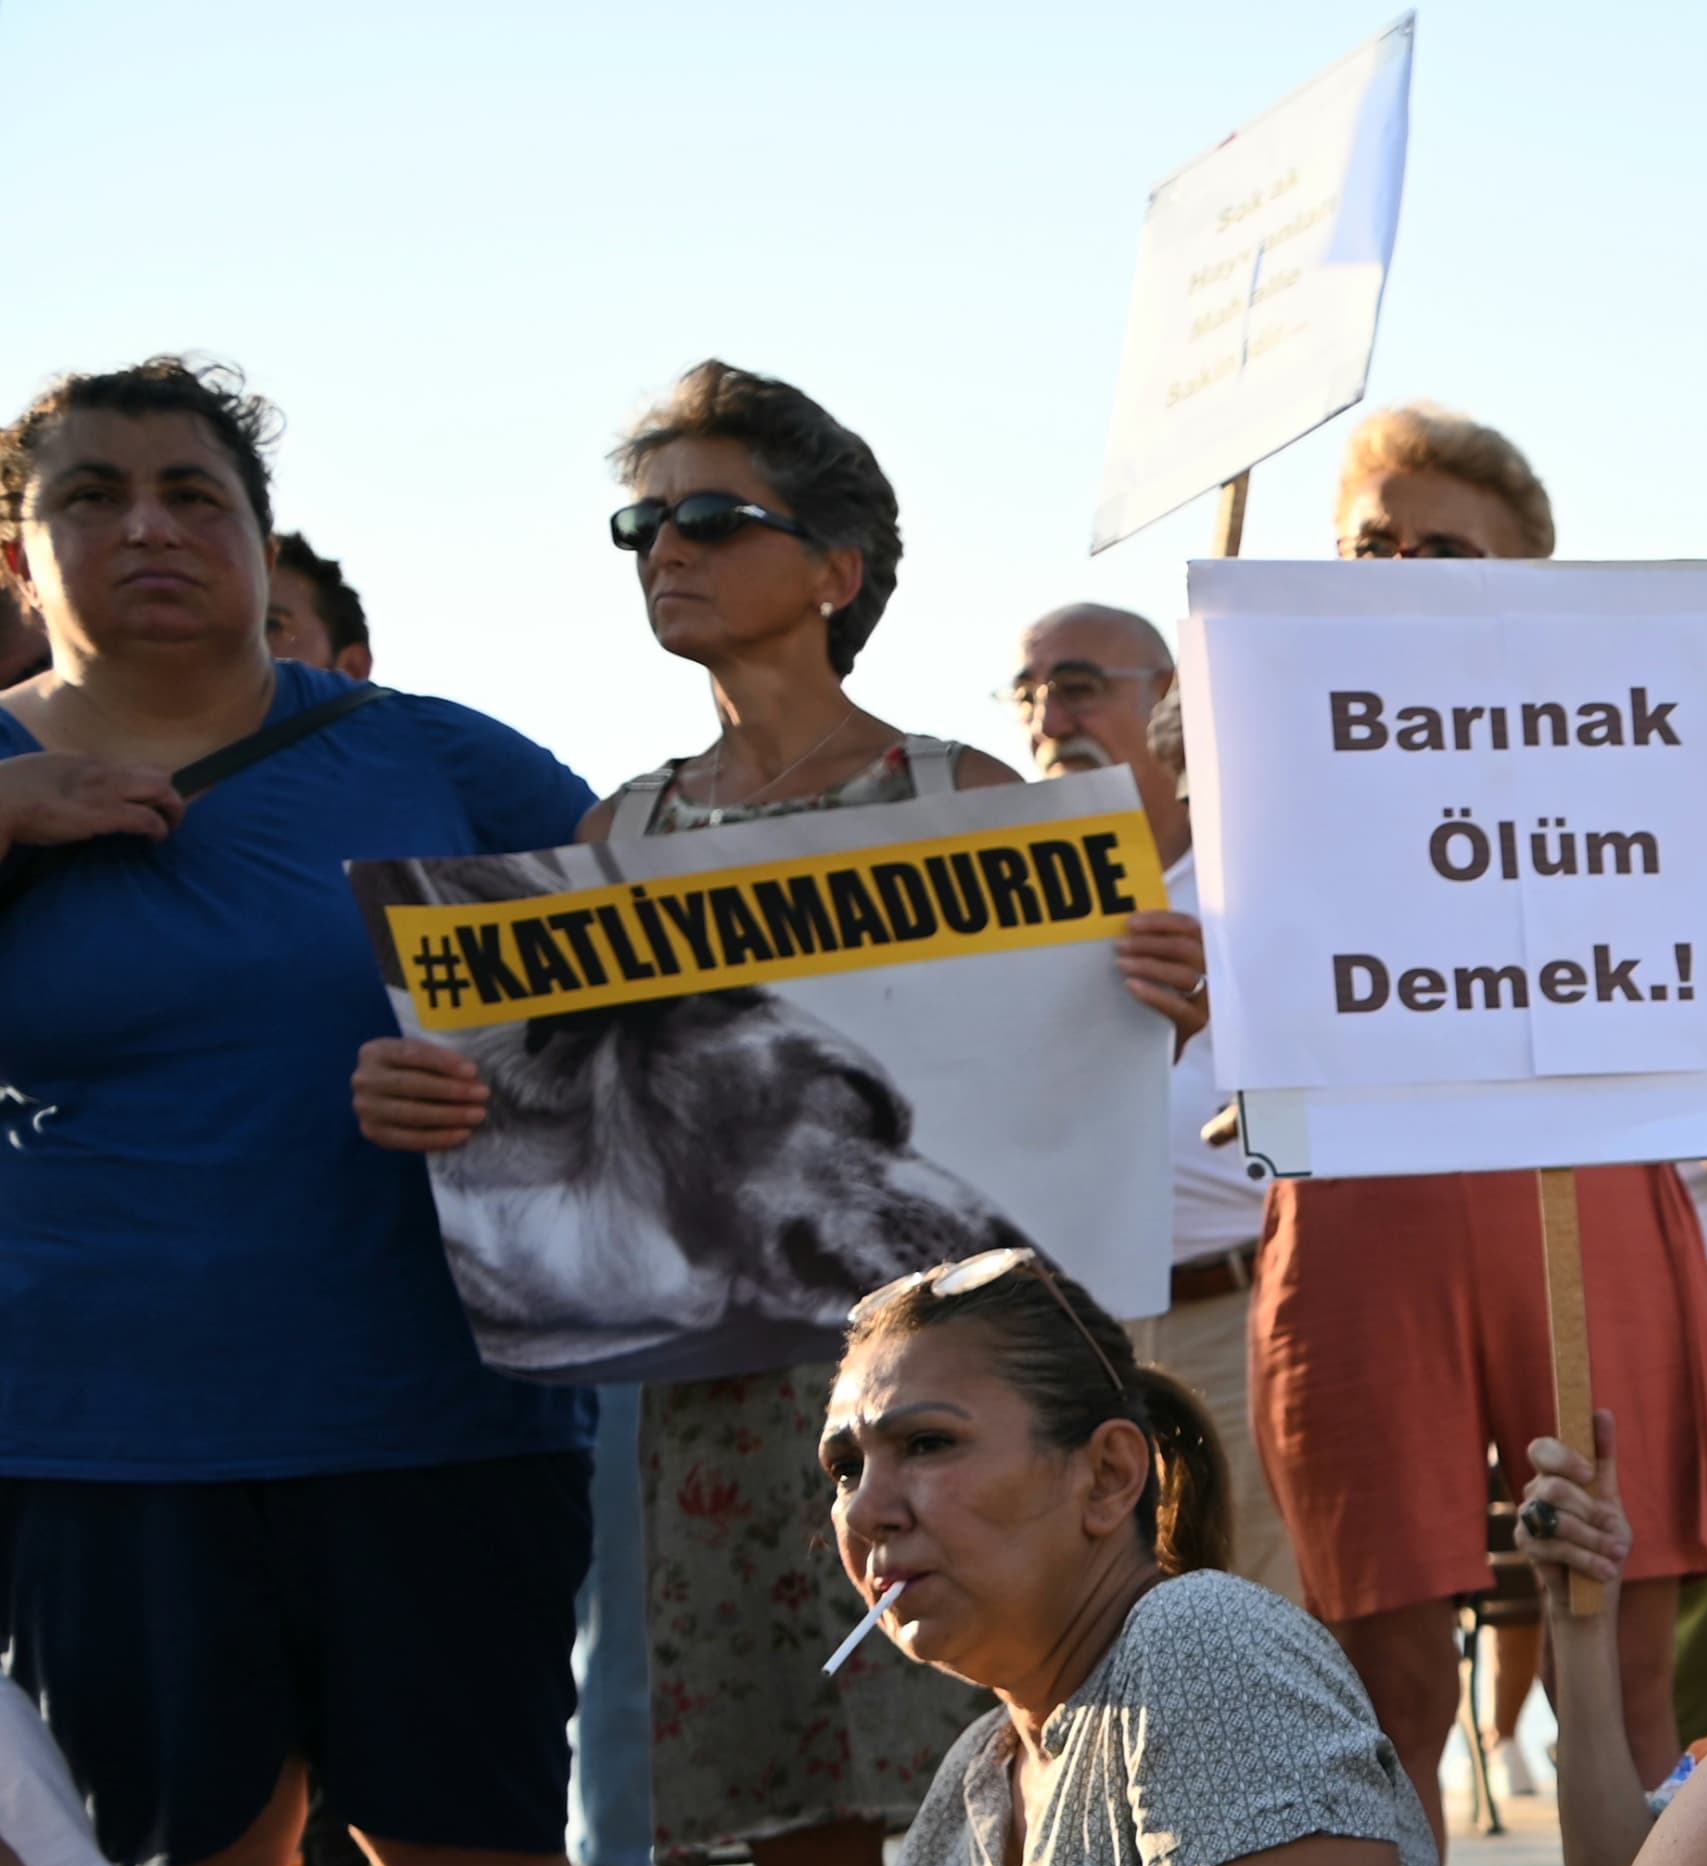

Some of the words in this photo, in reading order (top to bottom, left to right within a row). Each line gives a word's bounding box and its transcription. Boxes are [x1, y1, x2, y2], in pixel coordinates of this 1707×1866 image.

[1327, 685, 1684, 754] Barınak
[1427, 805, 1661, 883] Ölüm
[412, 831, 1136, 1010] #KATLİYAMADURDE
[1331, 942, 1697, 1016] Demek.!
